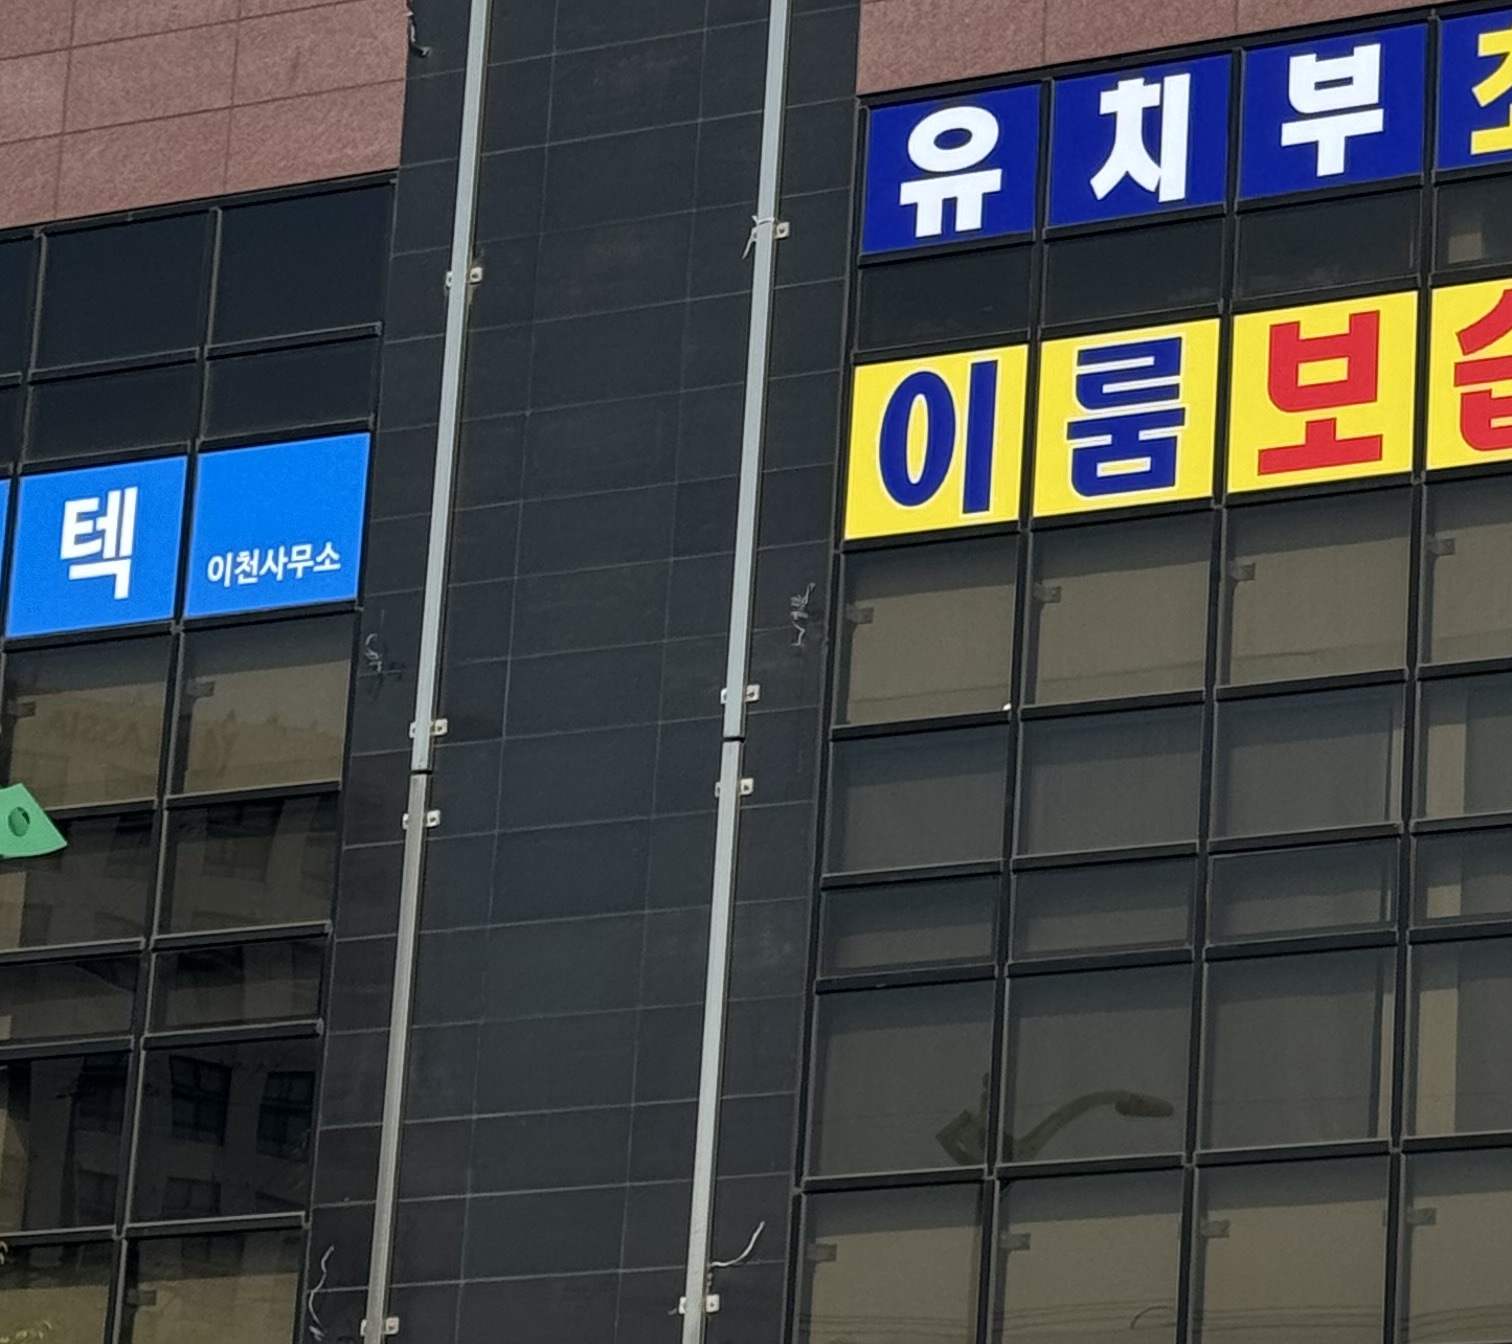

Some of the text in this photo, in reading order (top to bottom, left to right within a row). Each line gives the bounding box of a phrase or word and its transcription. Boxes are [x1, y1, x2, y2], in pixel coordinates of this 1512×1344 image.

[900, 42, 1385, 238] 유치부
[877, 335, 1186, 516] 이룸
[60, 486, 139, 600] 텍
[206, 541, 342, 587] 이천사무소
